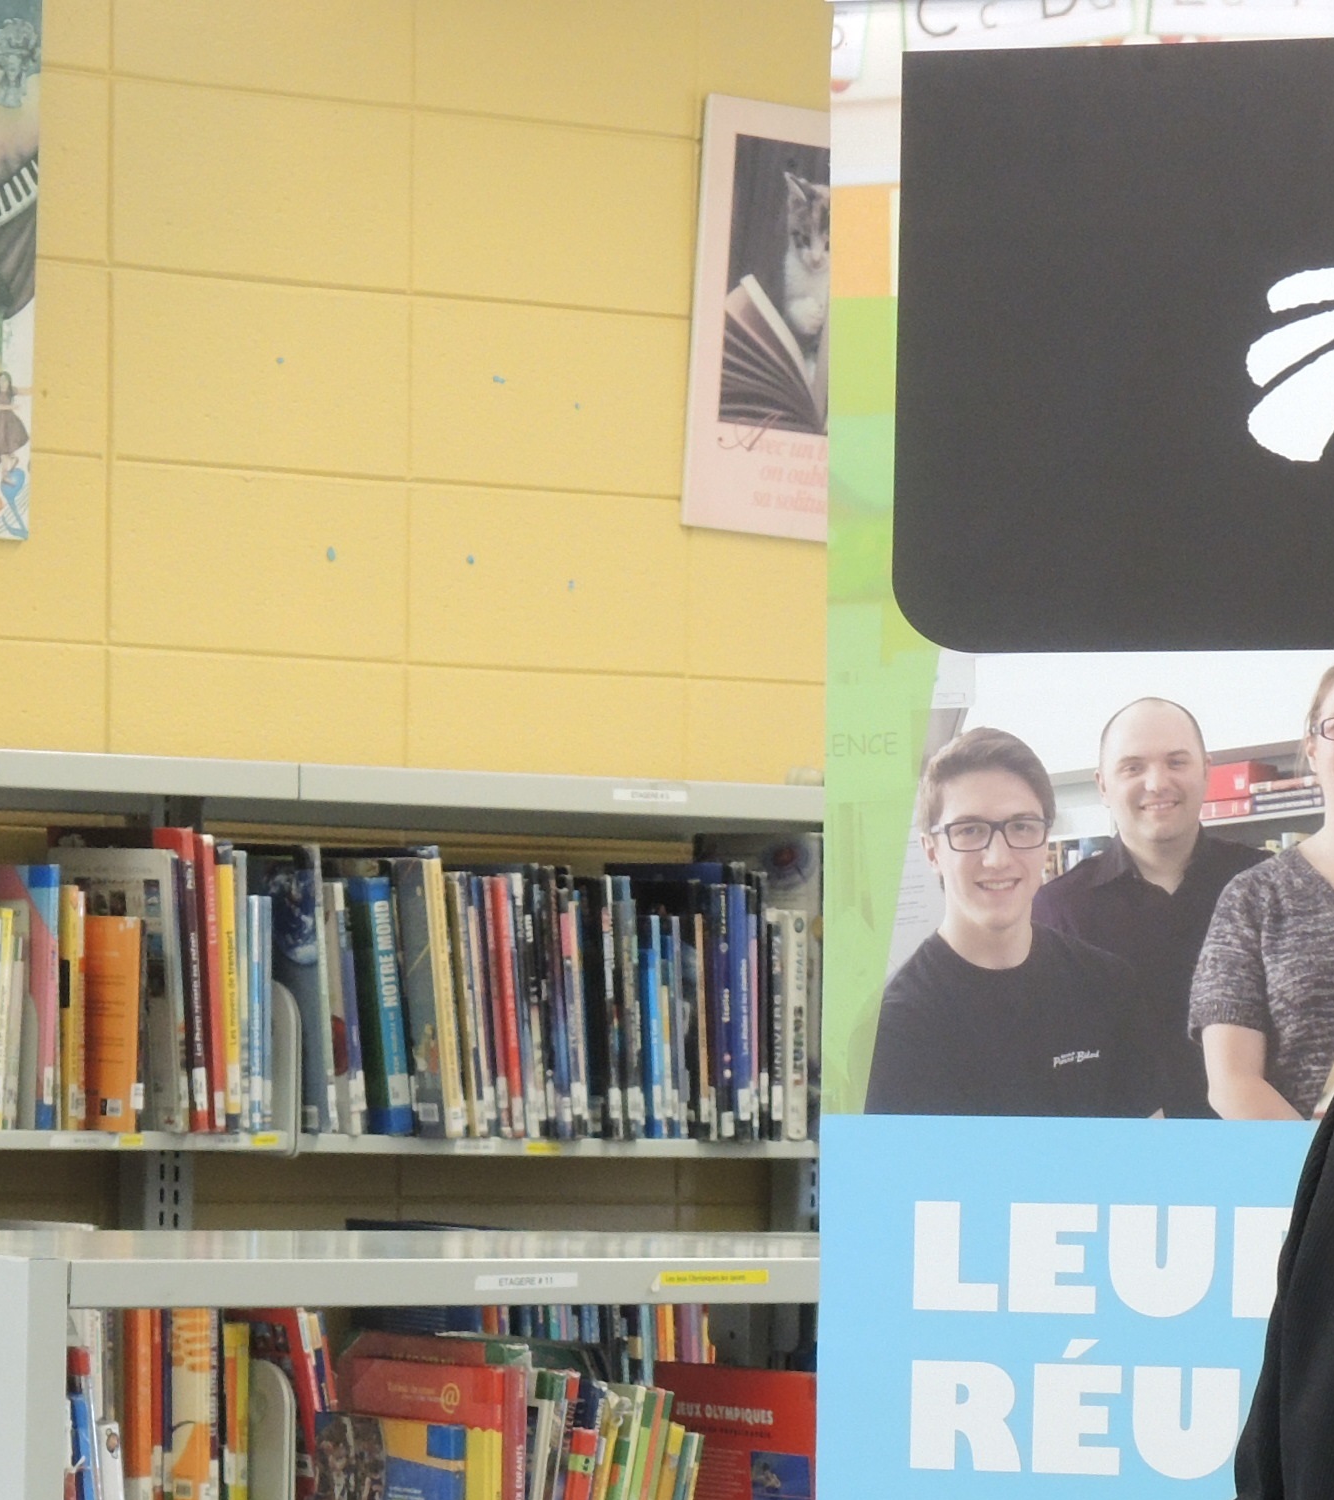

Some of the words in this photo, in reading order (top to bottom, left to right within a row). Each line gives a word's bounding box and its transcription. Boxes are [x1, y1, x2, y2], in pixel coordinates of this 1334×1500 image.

[787, 462, 828, 488] oubl
[774, 489, 828, 514] solitu
[830, 731, 899, 758] ENCE
[373, 899, 393, 951] MOND
[379, 954, 399, 1008] NOTRE
[675, 1401, 702, 1419] JEUX
[704, 1402, 774, 1426] OLYMPIQUES
[910, 1338, 1241, 1480] RÉU
[515, 1444, 524, 1489] ENFANTS
